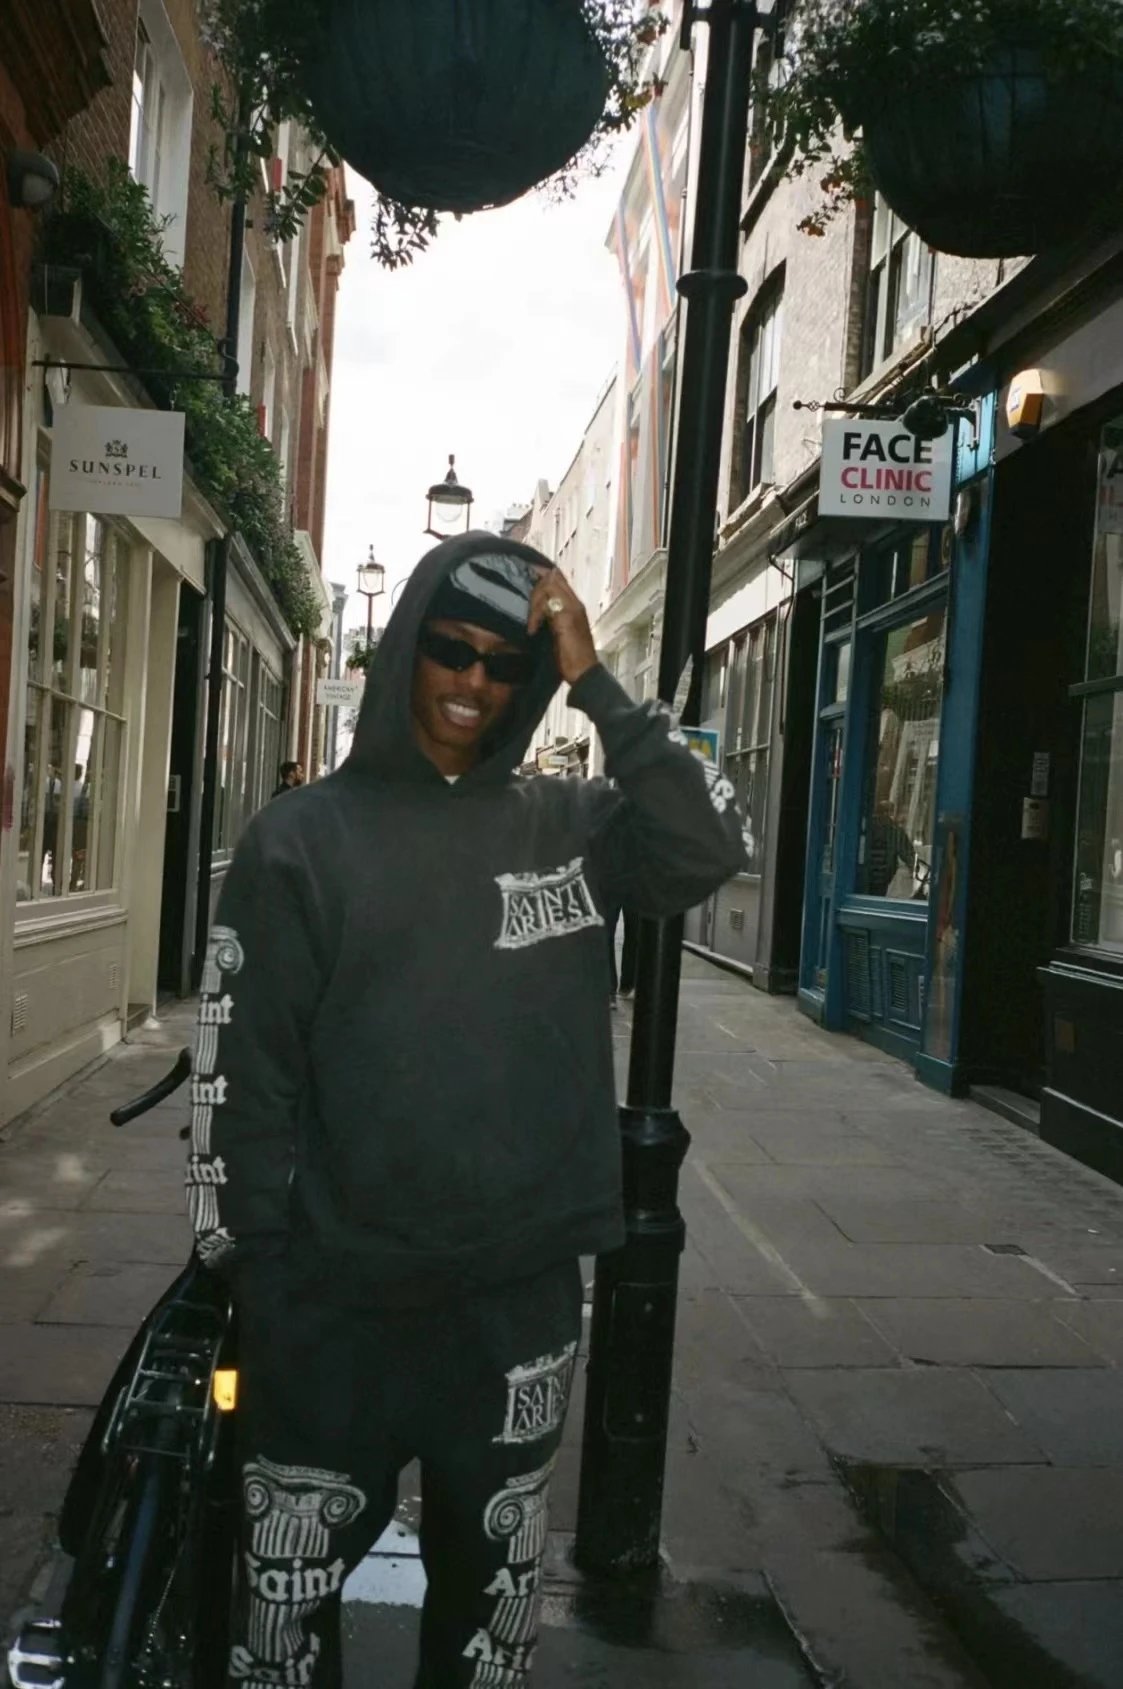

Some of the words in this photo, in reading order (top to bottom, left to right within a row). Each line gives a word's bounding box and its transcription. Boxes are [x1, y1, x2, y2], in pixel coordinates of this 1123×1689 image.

[842, 431, 933, 465] FACE
[68, 458, 162, 480] SUNSPEL
[840, 466, 933, 493] CLINIC
[839, 494, 932, 507] LONDON
